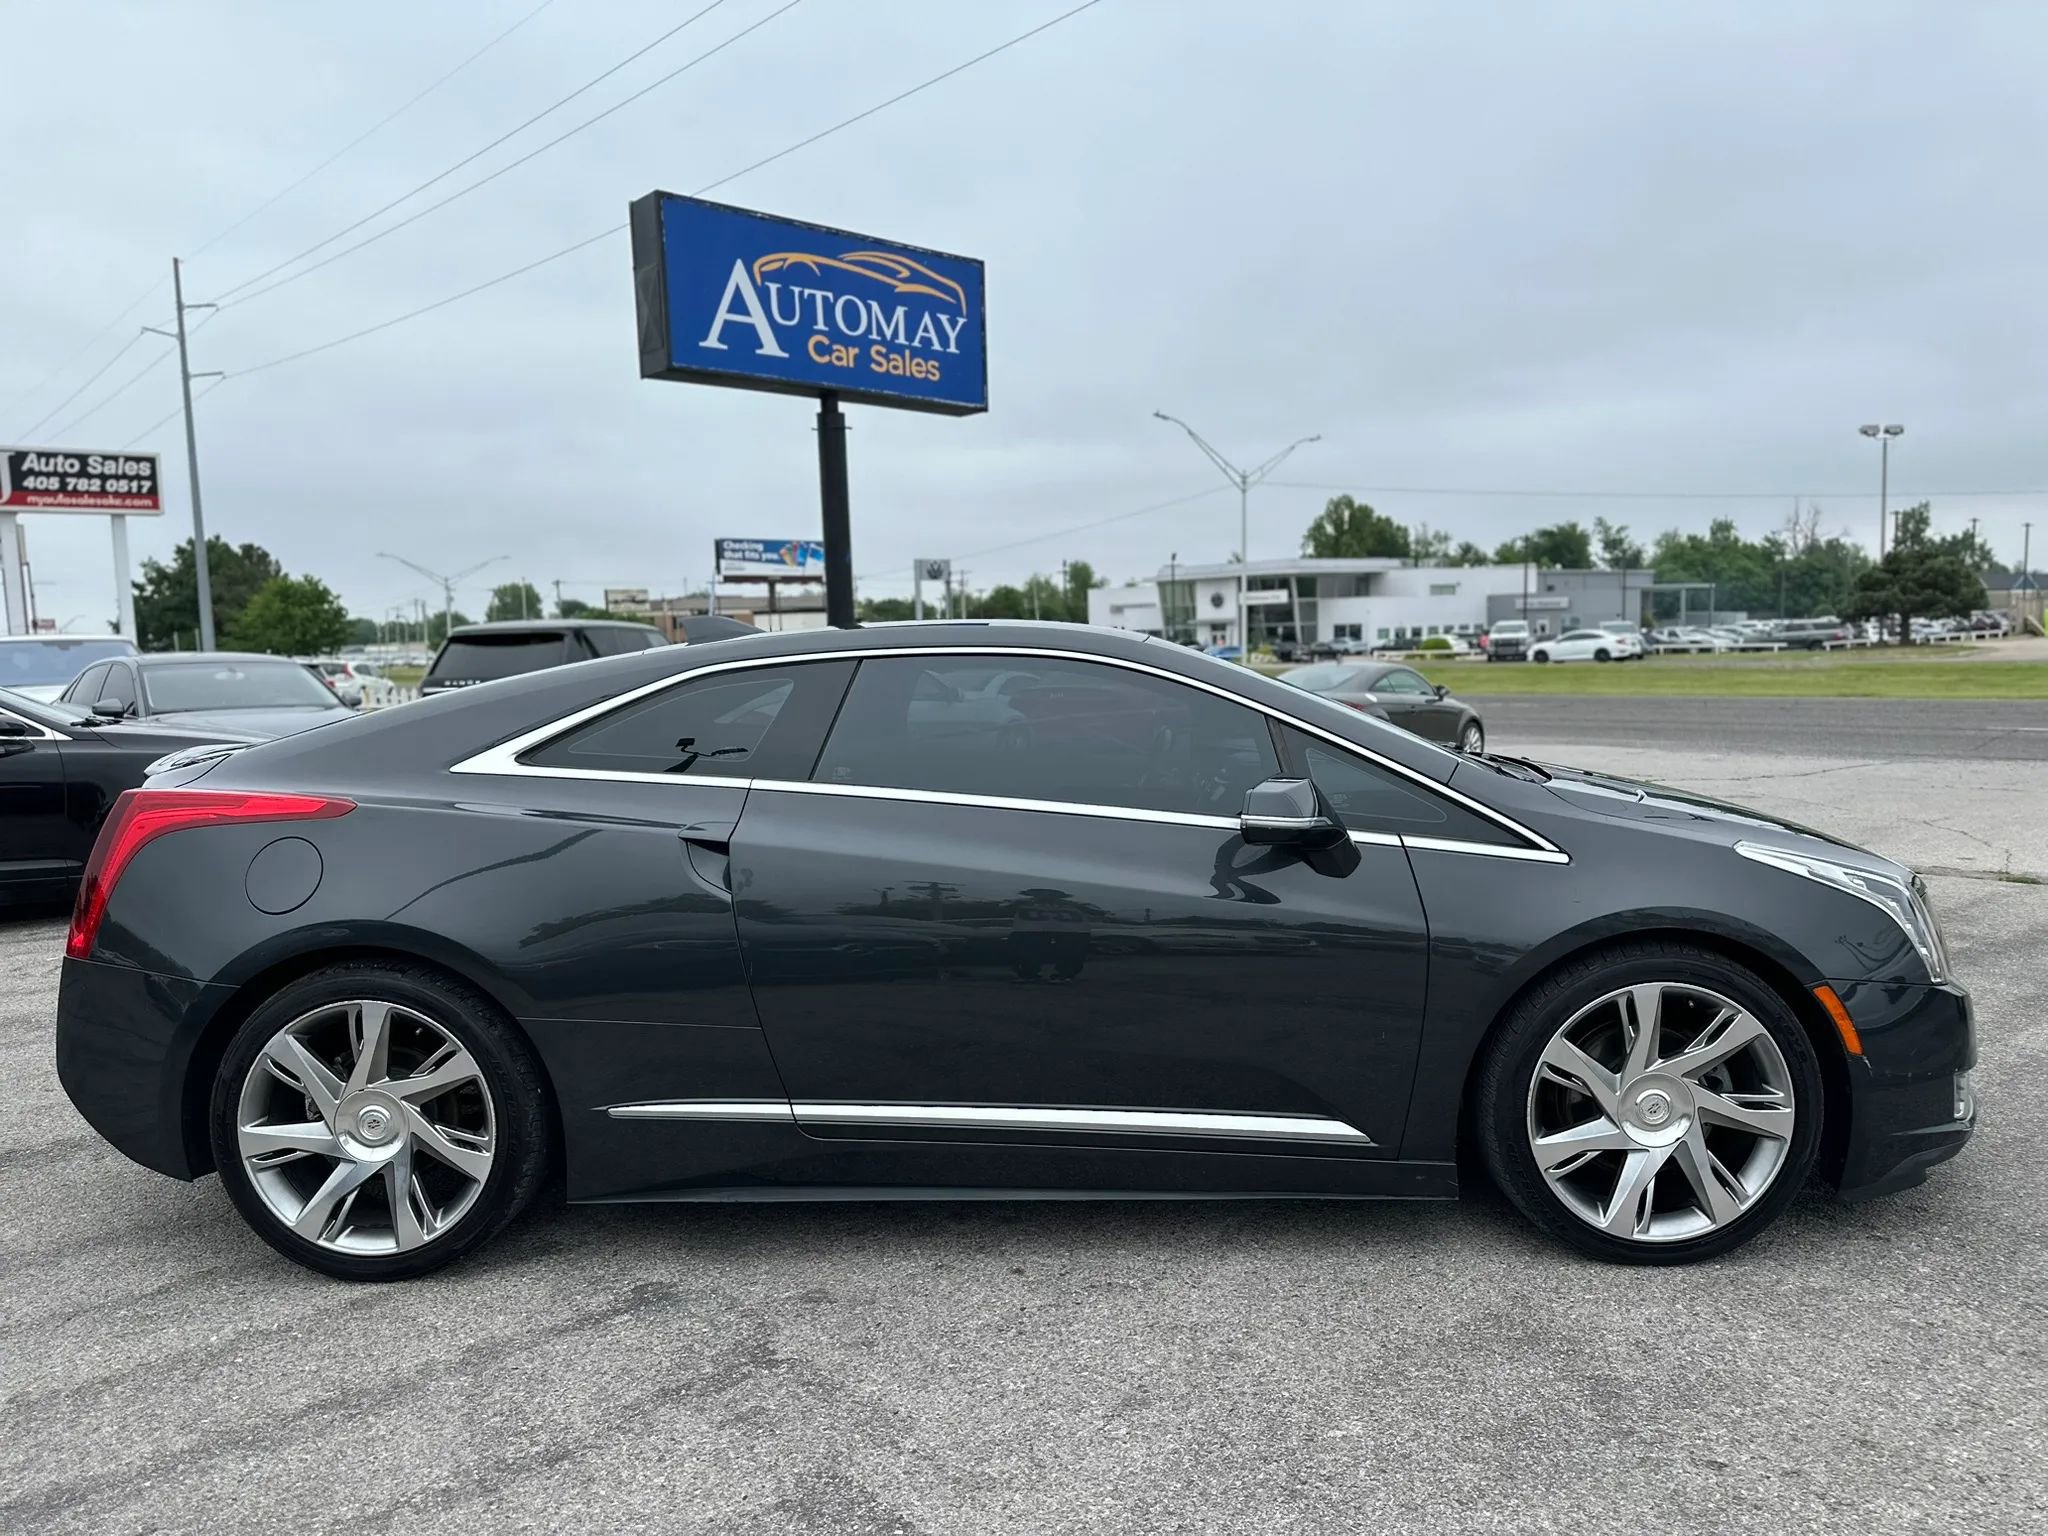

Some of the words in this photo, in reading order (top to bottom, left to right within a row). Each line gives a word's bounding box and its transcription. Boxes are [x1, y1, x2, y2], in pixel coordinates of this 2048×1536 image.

[699, 258, 967, 358] AUTOMAY
[808, 335, 859, 369] Car
[870, 344, 941, 382] Sales
[21, 453, 81, 474] Auto
[86, 456, 152, 476] Sales
[22, 476, 60, 490] 405
[66, 478, 102, 492] 782
[105, 480, 152, 494] 0517
